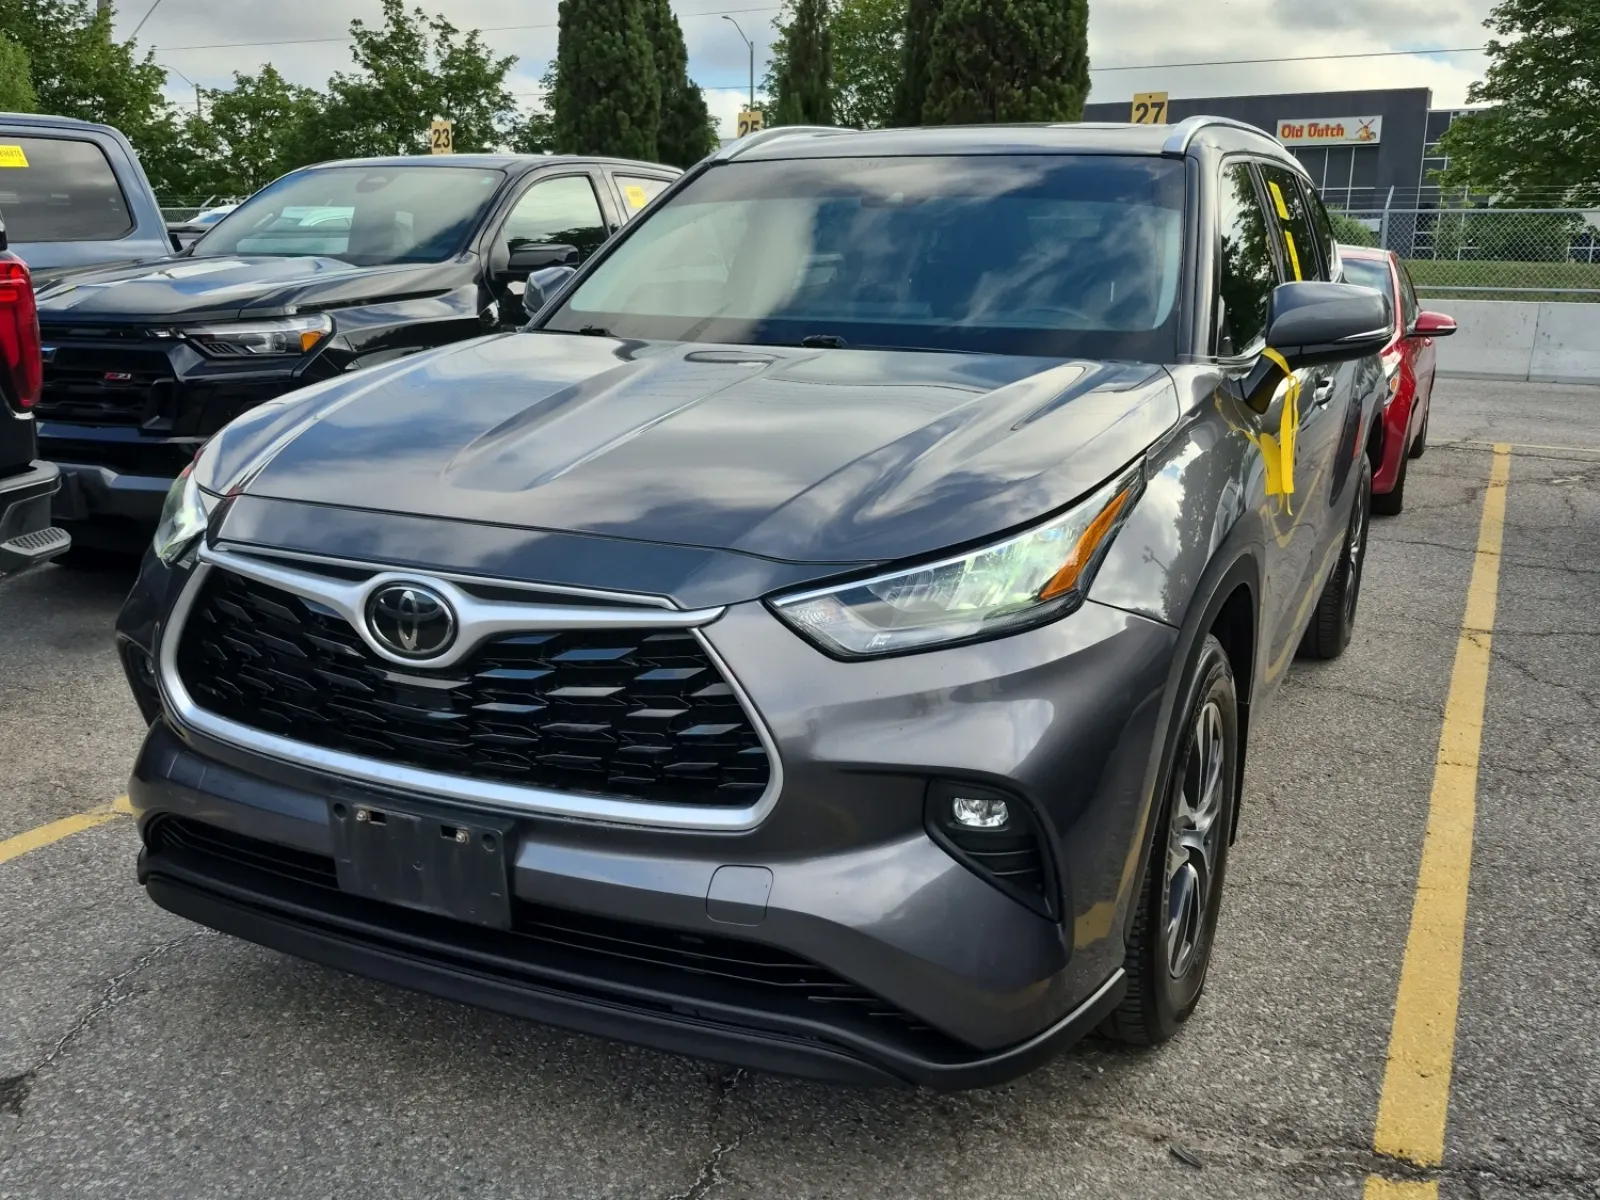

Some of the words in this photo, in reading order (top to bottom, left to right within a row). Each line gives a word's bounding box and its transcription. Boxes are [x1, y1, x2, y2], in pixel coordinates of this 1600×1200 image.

[1135, 102, 1165, 123] 27
[433, 128, 450, 148] 23
[1281, 124, 1304, 138] Old
[1308, 122, 1345, 138] Dutch
